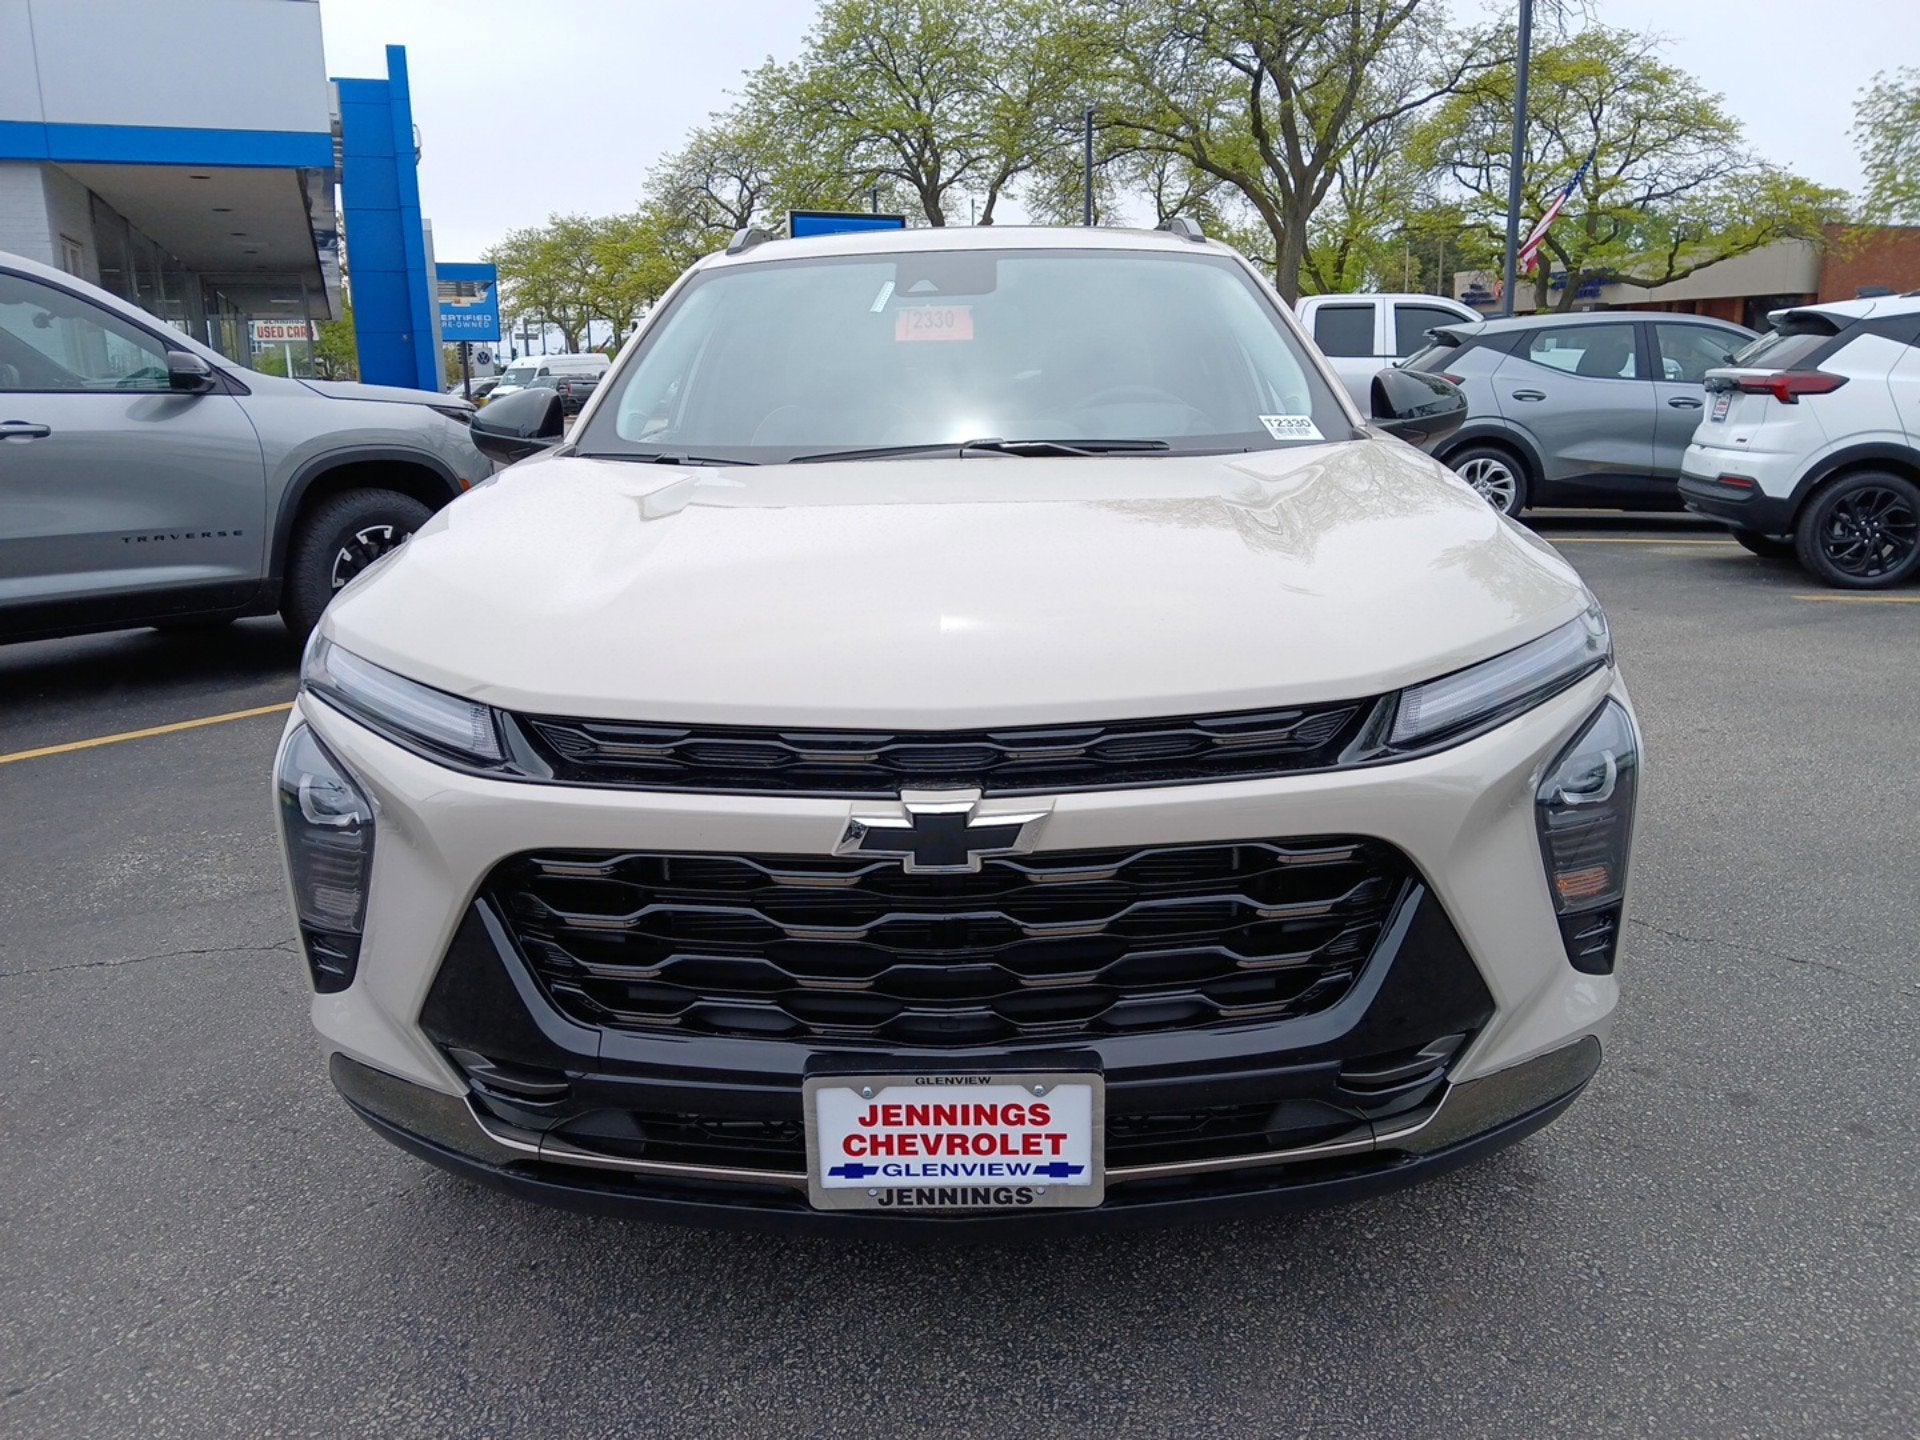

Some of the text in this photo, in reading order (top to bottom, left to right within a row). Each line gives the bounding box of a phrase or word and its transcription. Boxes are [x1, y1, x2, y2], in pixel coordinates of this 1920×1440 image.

[256, 326, 284, 338] USED
[441, 321, 490, 329] RE-OWNED
[1264, 418, 1312, 428] T2330
[121, 529, 243, 543] TRAVERSE
[915, 1076, 992, 1086] GLENVIEW
[858, 1103, 1051, 1128] JENNINGS
[842, 1133, 1067, 1157] CHEVROLET
[882, 1162, 1032, 1178] GLENVIEW
[878, 1186, 1034, 1207] JENNINGS
